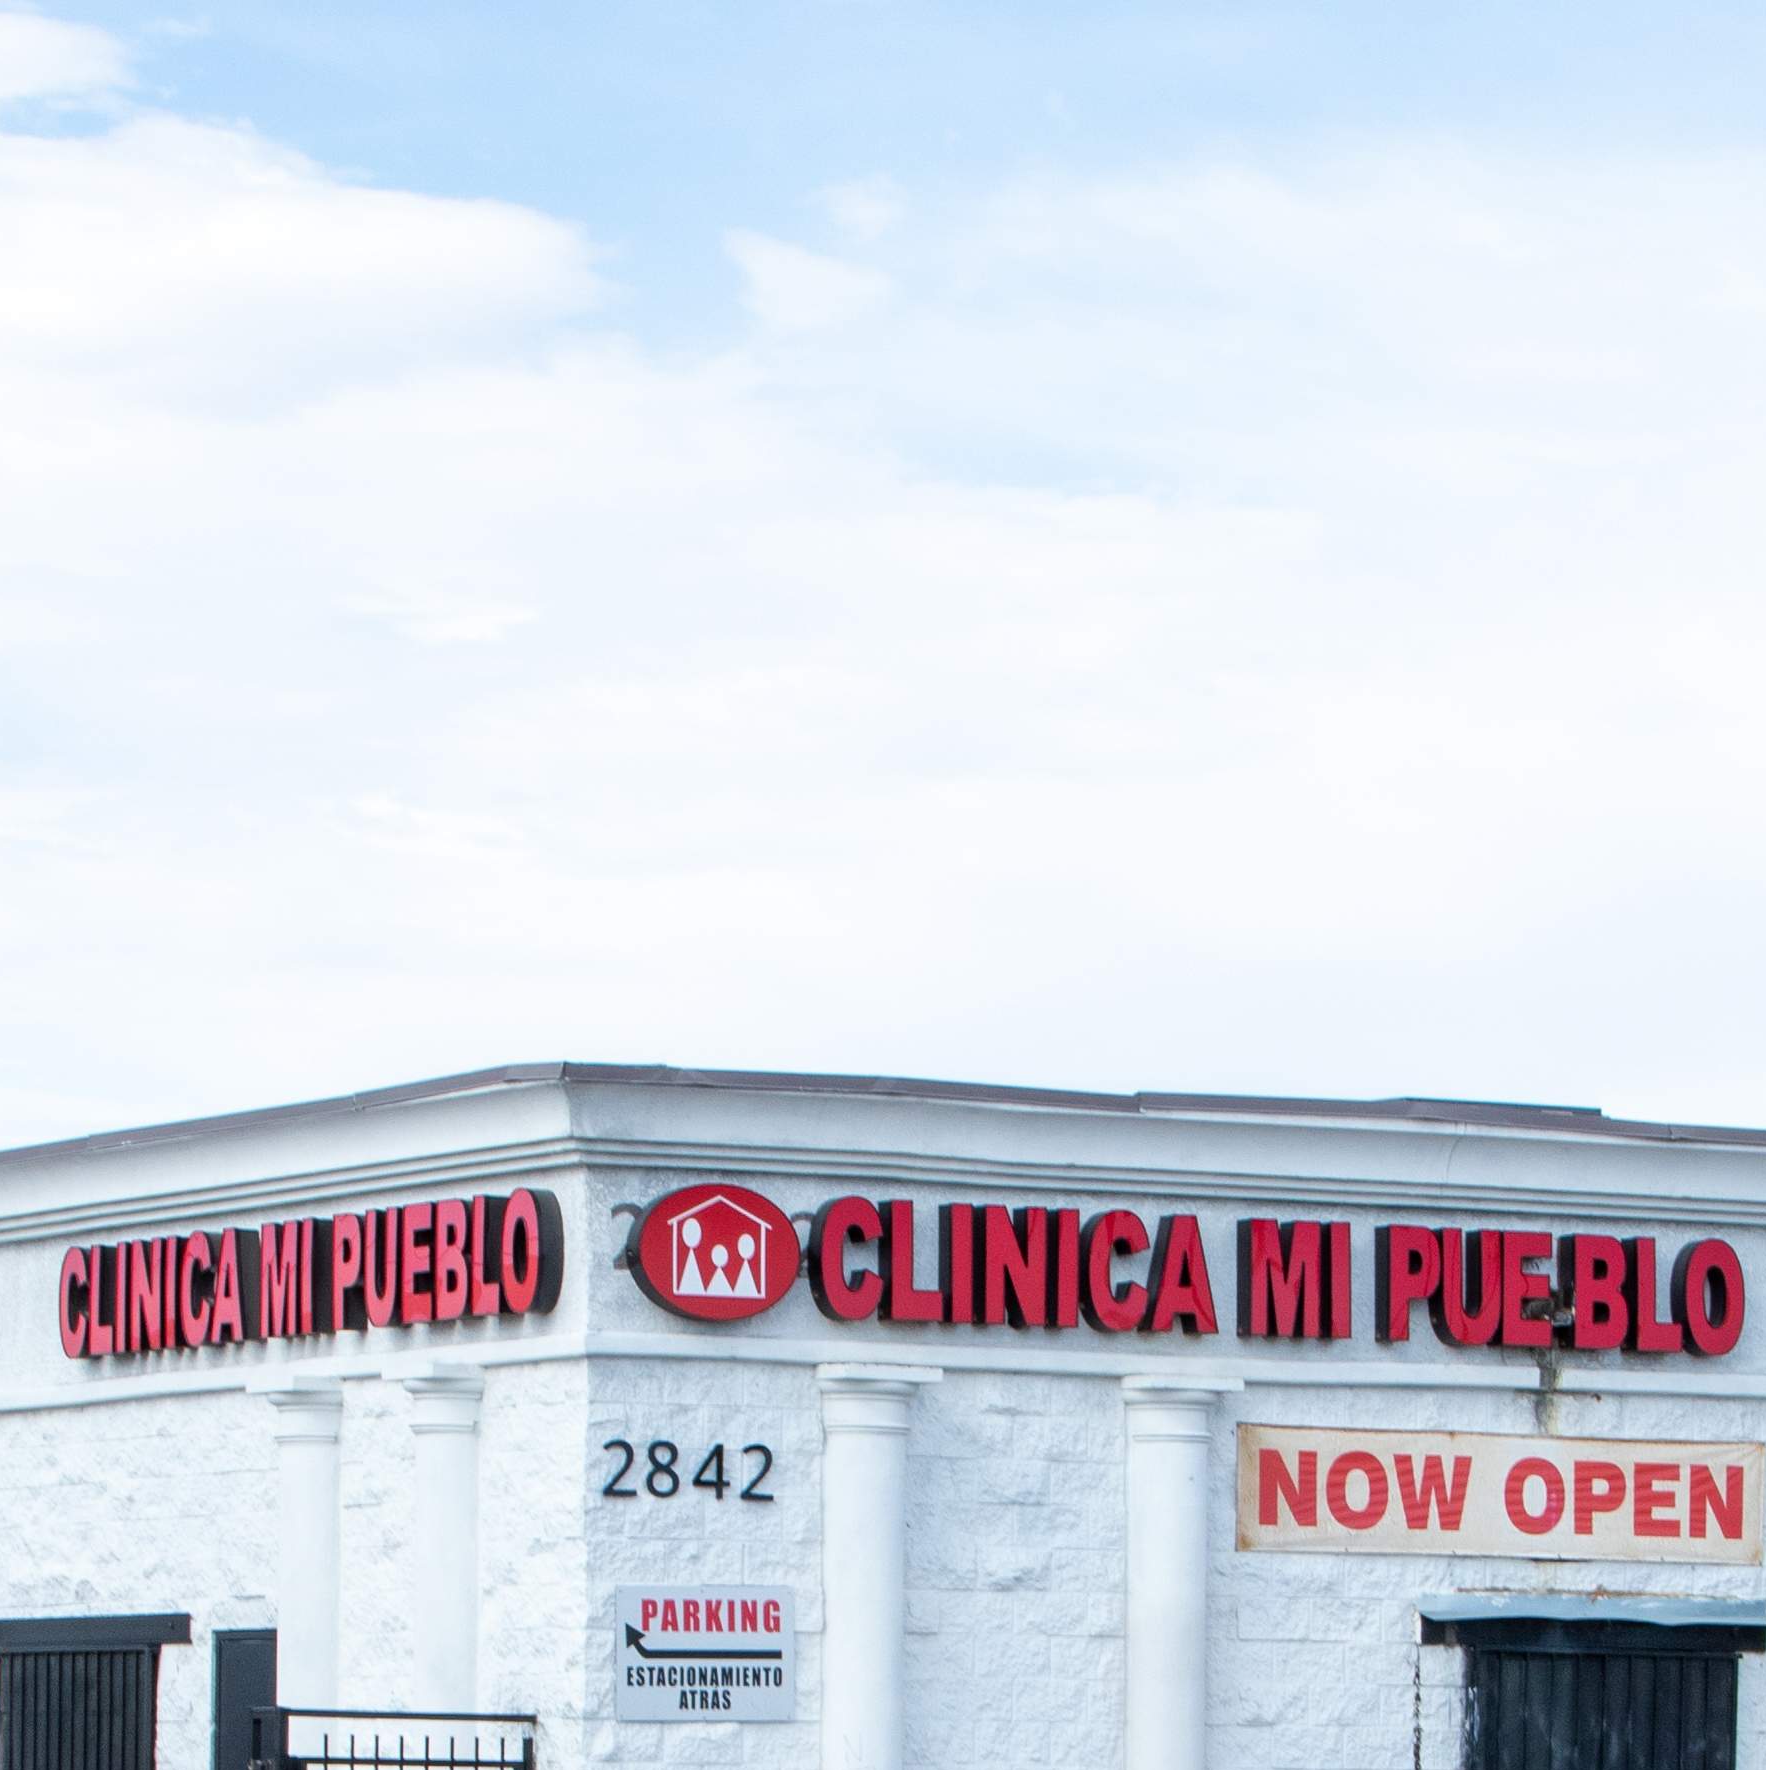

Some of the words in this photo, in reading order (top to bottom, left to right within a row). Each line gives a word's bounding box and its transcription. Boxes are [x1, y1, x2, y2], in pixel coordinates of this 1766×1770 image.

[59, 1228, 255, 1360] CLINICA
[260, 1216, 328, 1338] MI
[333, 1187, 563, 1332] PUEBLO
[810, 1196, 1219, 1335] CLINICA
[1237, 1218, 1352, 1340] MI
[1375, 1224, 1746, 1356] PUEBLO
[601, 1438, 775, 1501] 2842
[1257, 1447, 1471, 1533] NOW
[1501, 1456, 1745, 1542] OPEN
[640, 1598, 782, 1633] PARKING
[625, 1665, 784, 1688] ESTACIONAMIENTO
